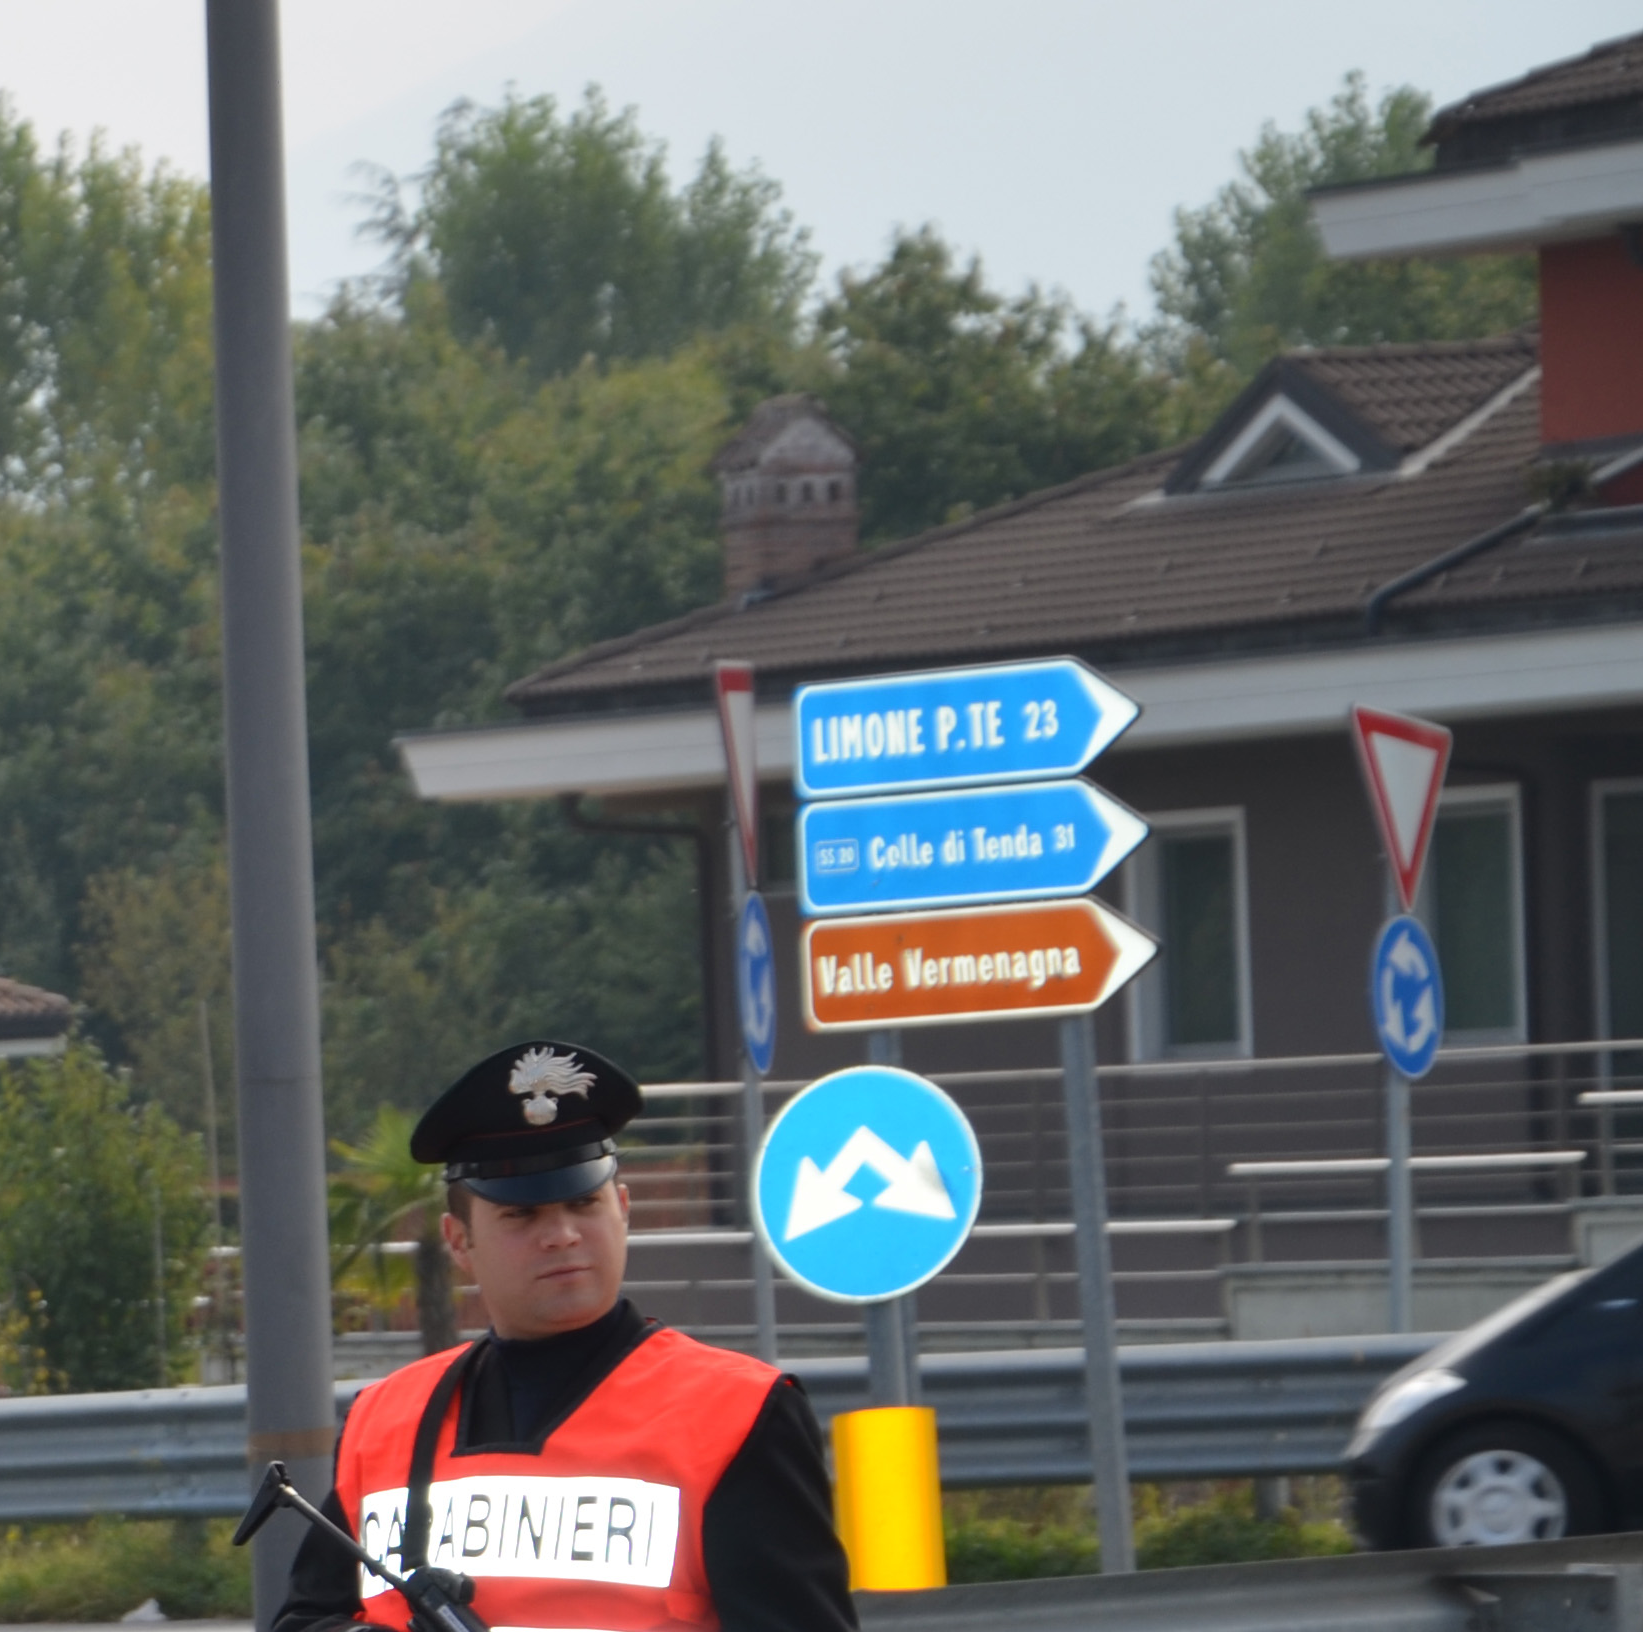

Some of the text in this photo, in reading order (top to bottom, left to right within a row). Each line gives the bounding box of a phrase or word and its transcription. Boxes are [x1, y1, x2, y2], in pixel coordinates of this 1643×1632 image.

[812, 699, 1060, 763] LIMONE P.TE 23
[819, 847, 836, 866] SS
[868, 831, 934, 869] Colle
[941, 830, 965, 863] di
[973, 825, 1043, 861] Tenda
[1052, 824, 1076, 852] 31
[819, 946, 1081, 996] Valle Vermenagna
[364, 1493, 655, 1572] CAABINIERI
